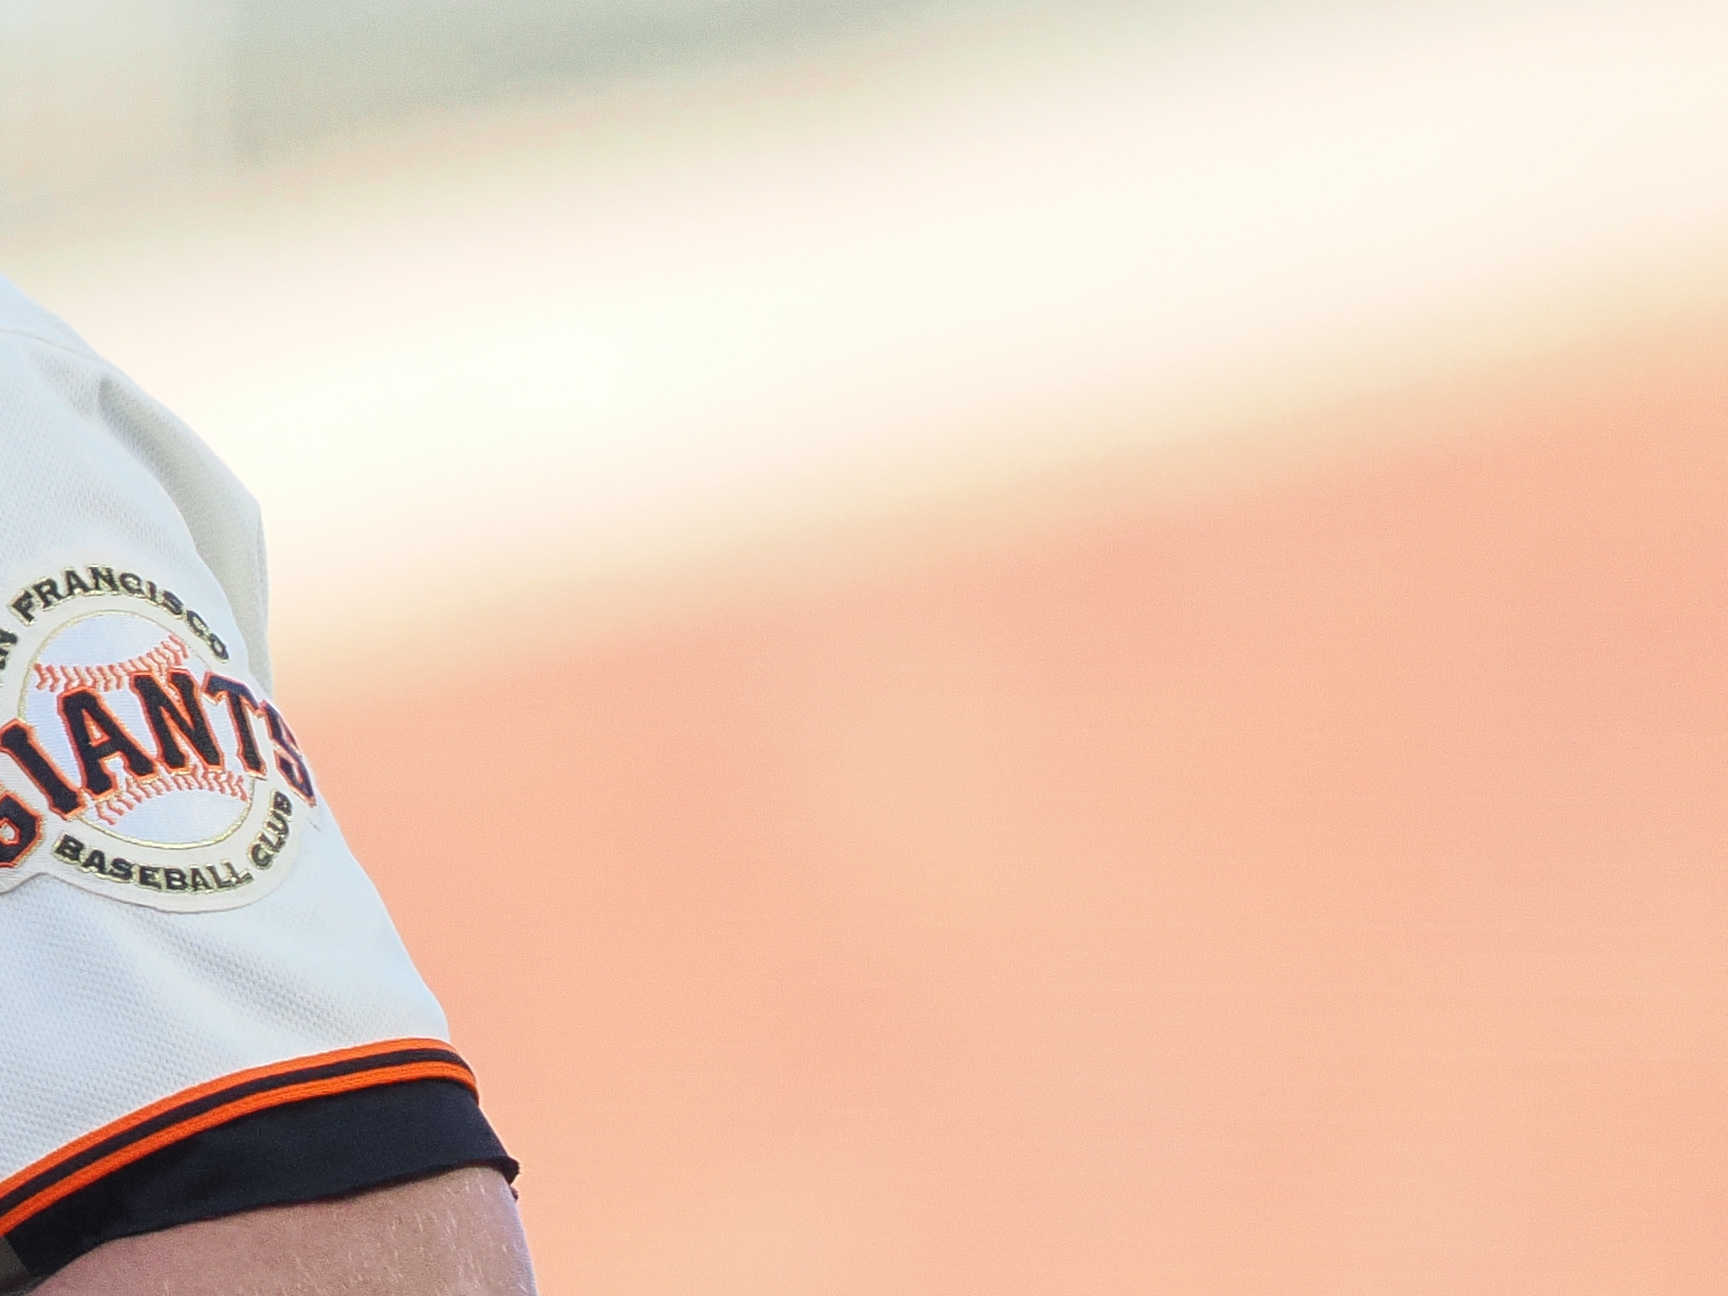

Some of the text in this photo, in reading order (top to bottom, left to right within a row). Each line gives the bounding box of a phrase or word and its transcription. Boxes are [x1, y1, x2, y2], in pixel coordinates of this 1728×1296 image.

[9, 564, 230, 663] FRANCISCO
[50, 788, 294, 896] BASEBALL CLUB
